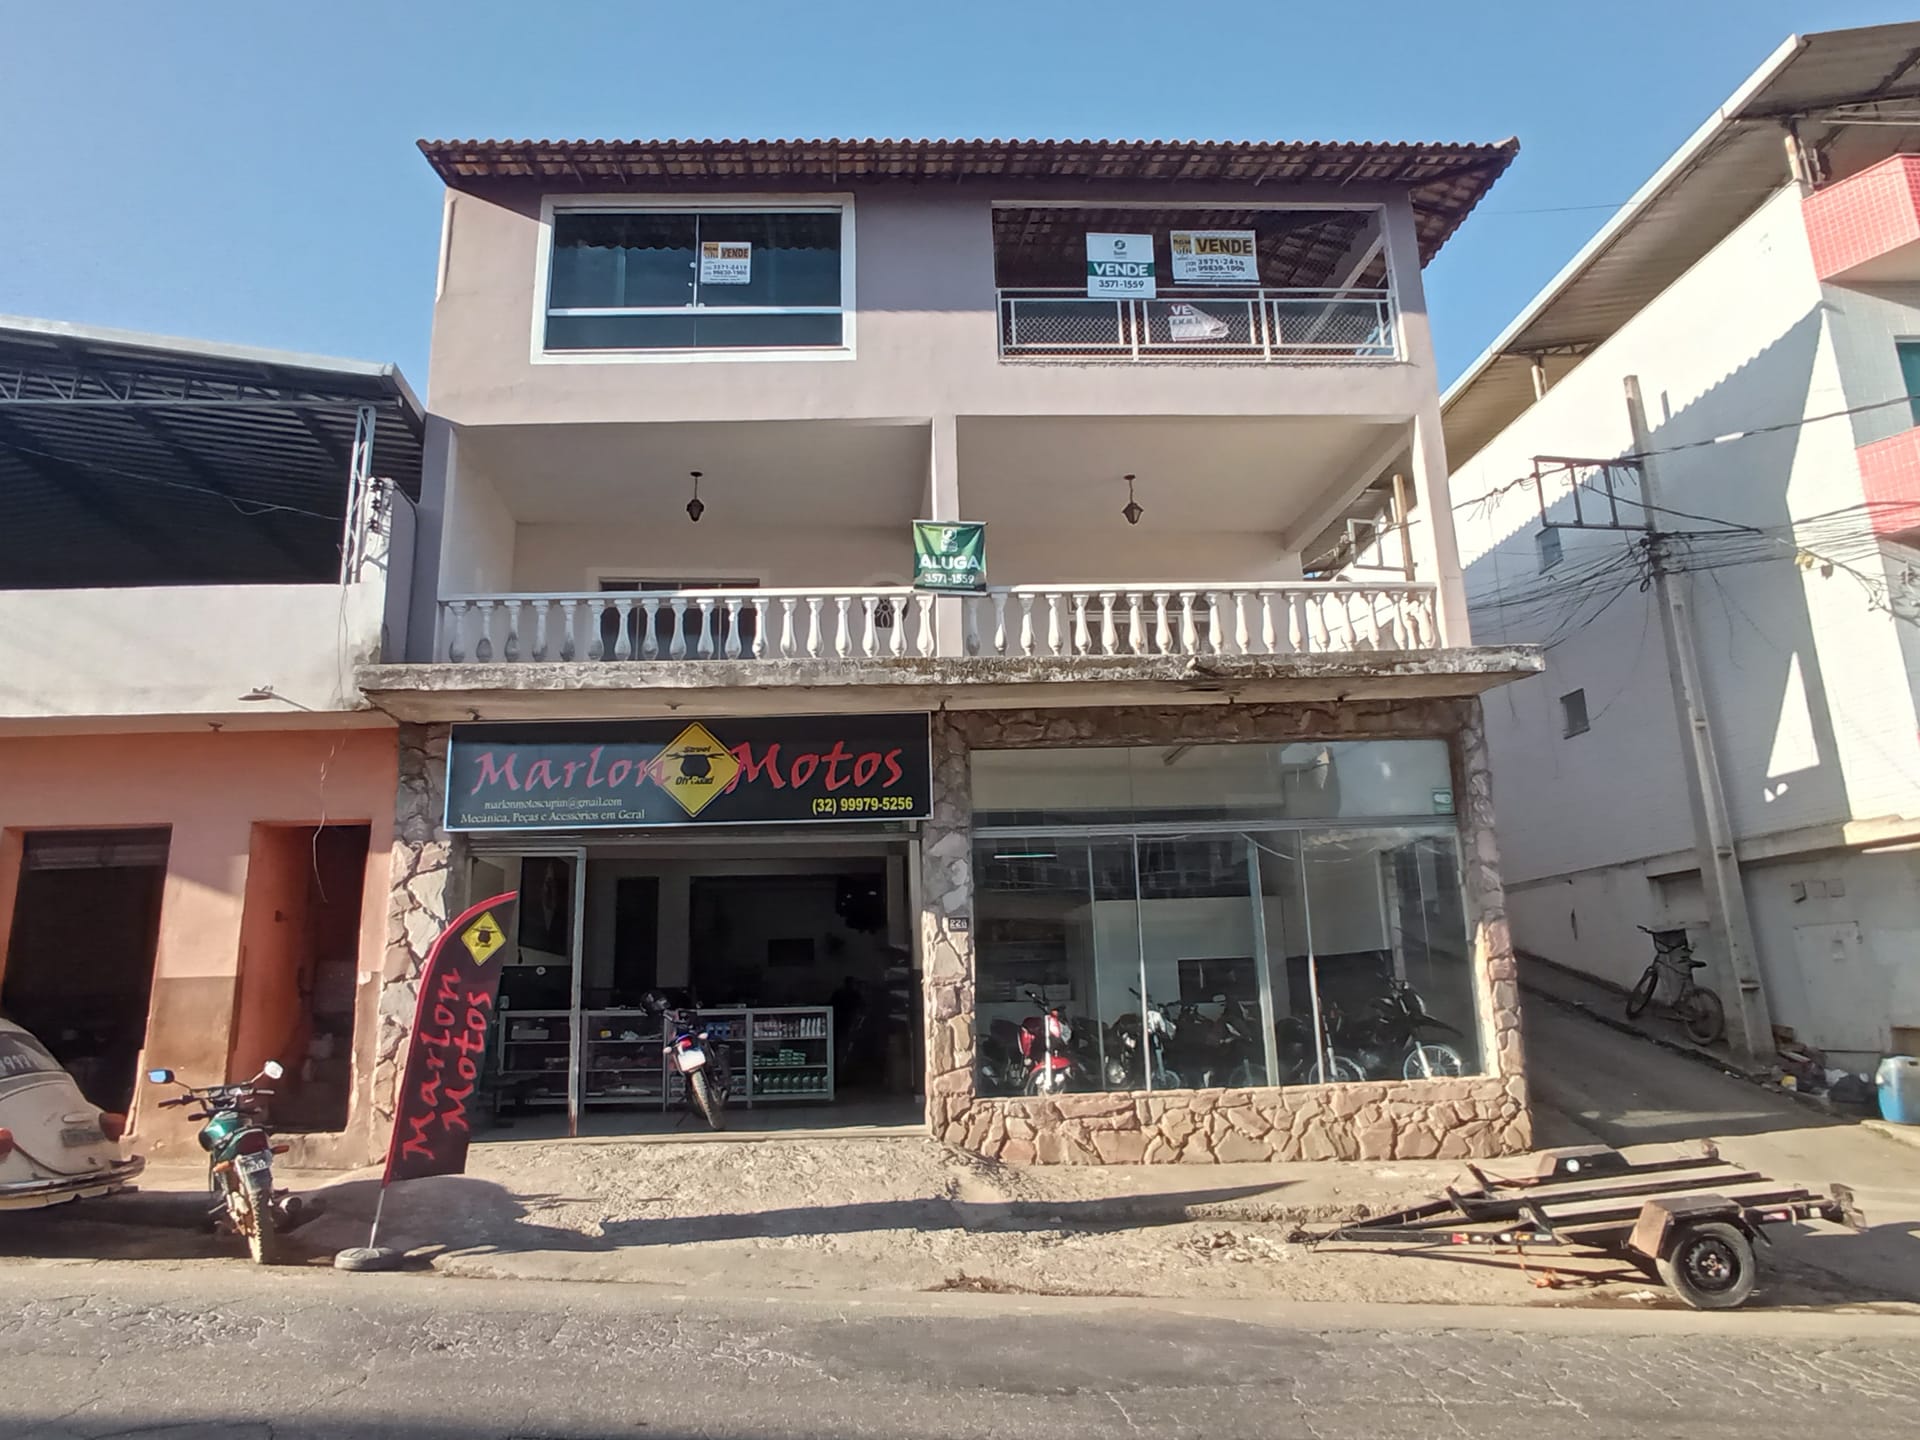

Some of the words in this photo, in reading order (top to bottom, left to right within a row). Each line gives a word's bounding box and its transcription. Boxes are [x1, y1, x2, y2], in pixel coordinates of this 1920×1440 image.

[721, 247, 749, 259] VENDE
[1196, 238, 1253, 254] VENDE
[1093, 263, 1149, 276] VENDE
[1098, 279, 1145, 289] 3571-1559
[919, 554, 981, 570] ALUGA
[924, 572, 975, 585] 3571-1559
[471, 745, 671, 796] Marlon
[724, 740, 902, 794] Motos
[812, 799, 837, 815] (32)
[840, 797, 914, 812] 99979-5256
[512, 812, 540, 824] Peças
[540, 813, 548, 822] e
[600, 811, 616, 821] em
[618, 808, 646, 820] Geral
[402, 967, 462, 1161] Marlon
[441, 990, 492, 1132] Motos
